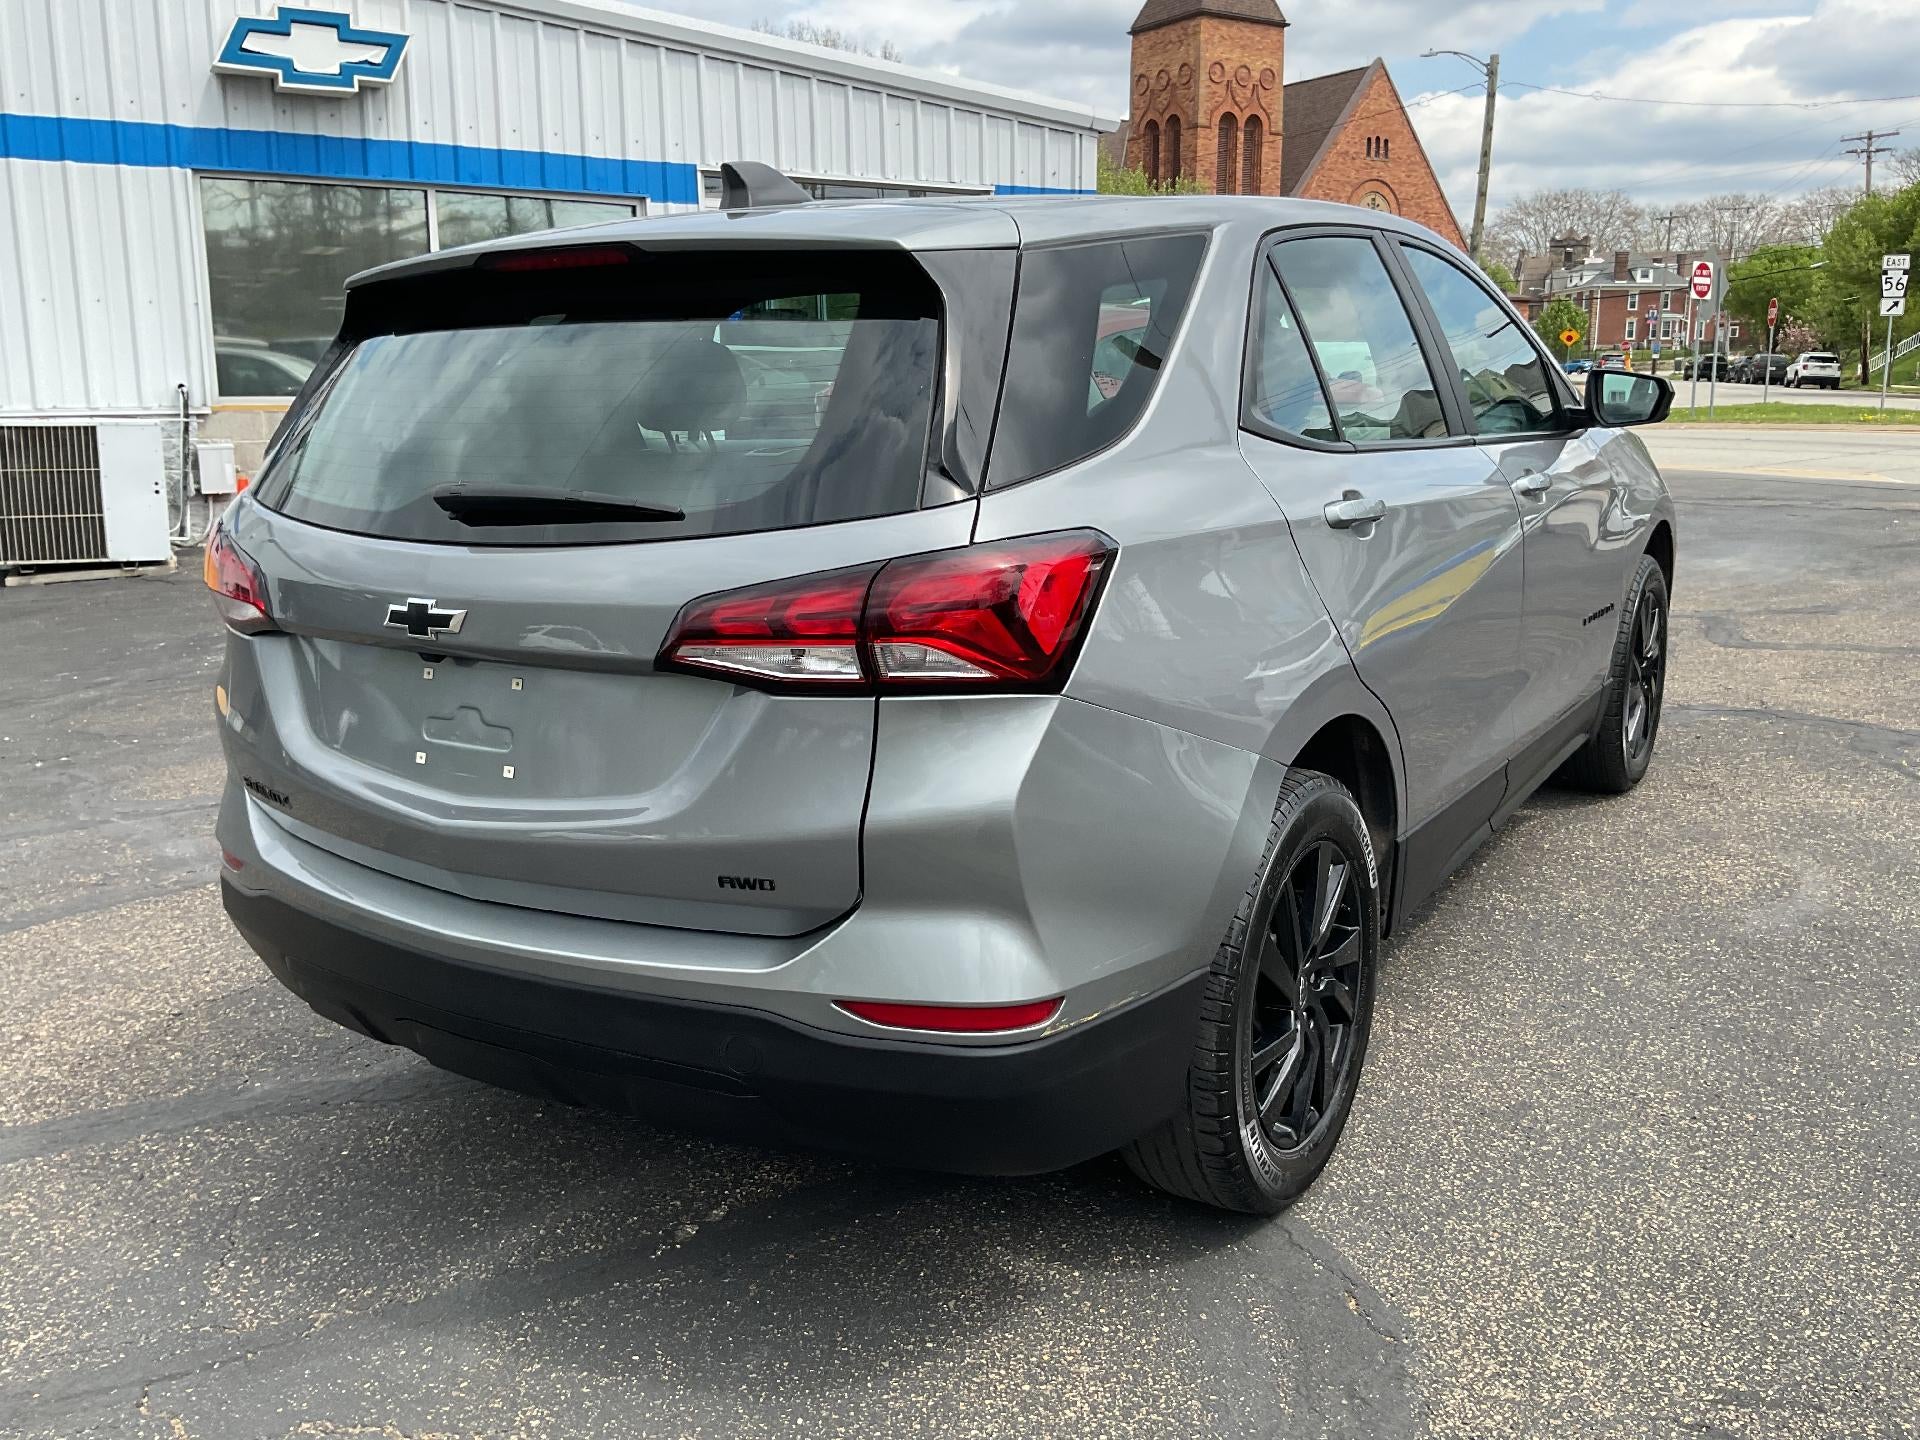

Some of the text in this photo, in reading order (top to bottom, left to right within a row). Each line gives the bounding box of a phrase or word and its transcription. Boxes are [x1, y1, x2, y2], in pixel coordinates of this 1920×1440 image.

[1886, 257, 1906, 266] EAST
[1884, 277, 1905, 291] 56
[718, 876, 776, 891] AWD
[1249, 1123, 1281, 1186] MICHELIN
